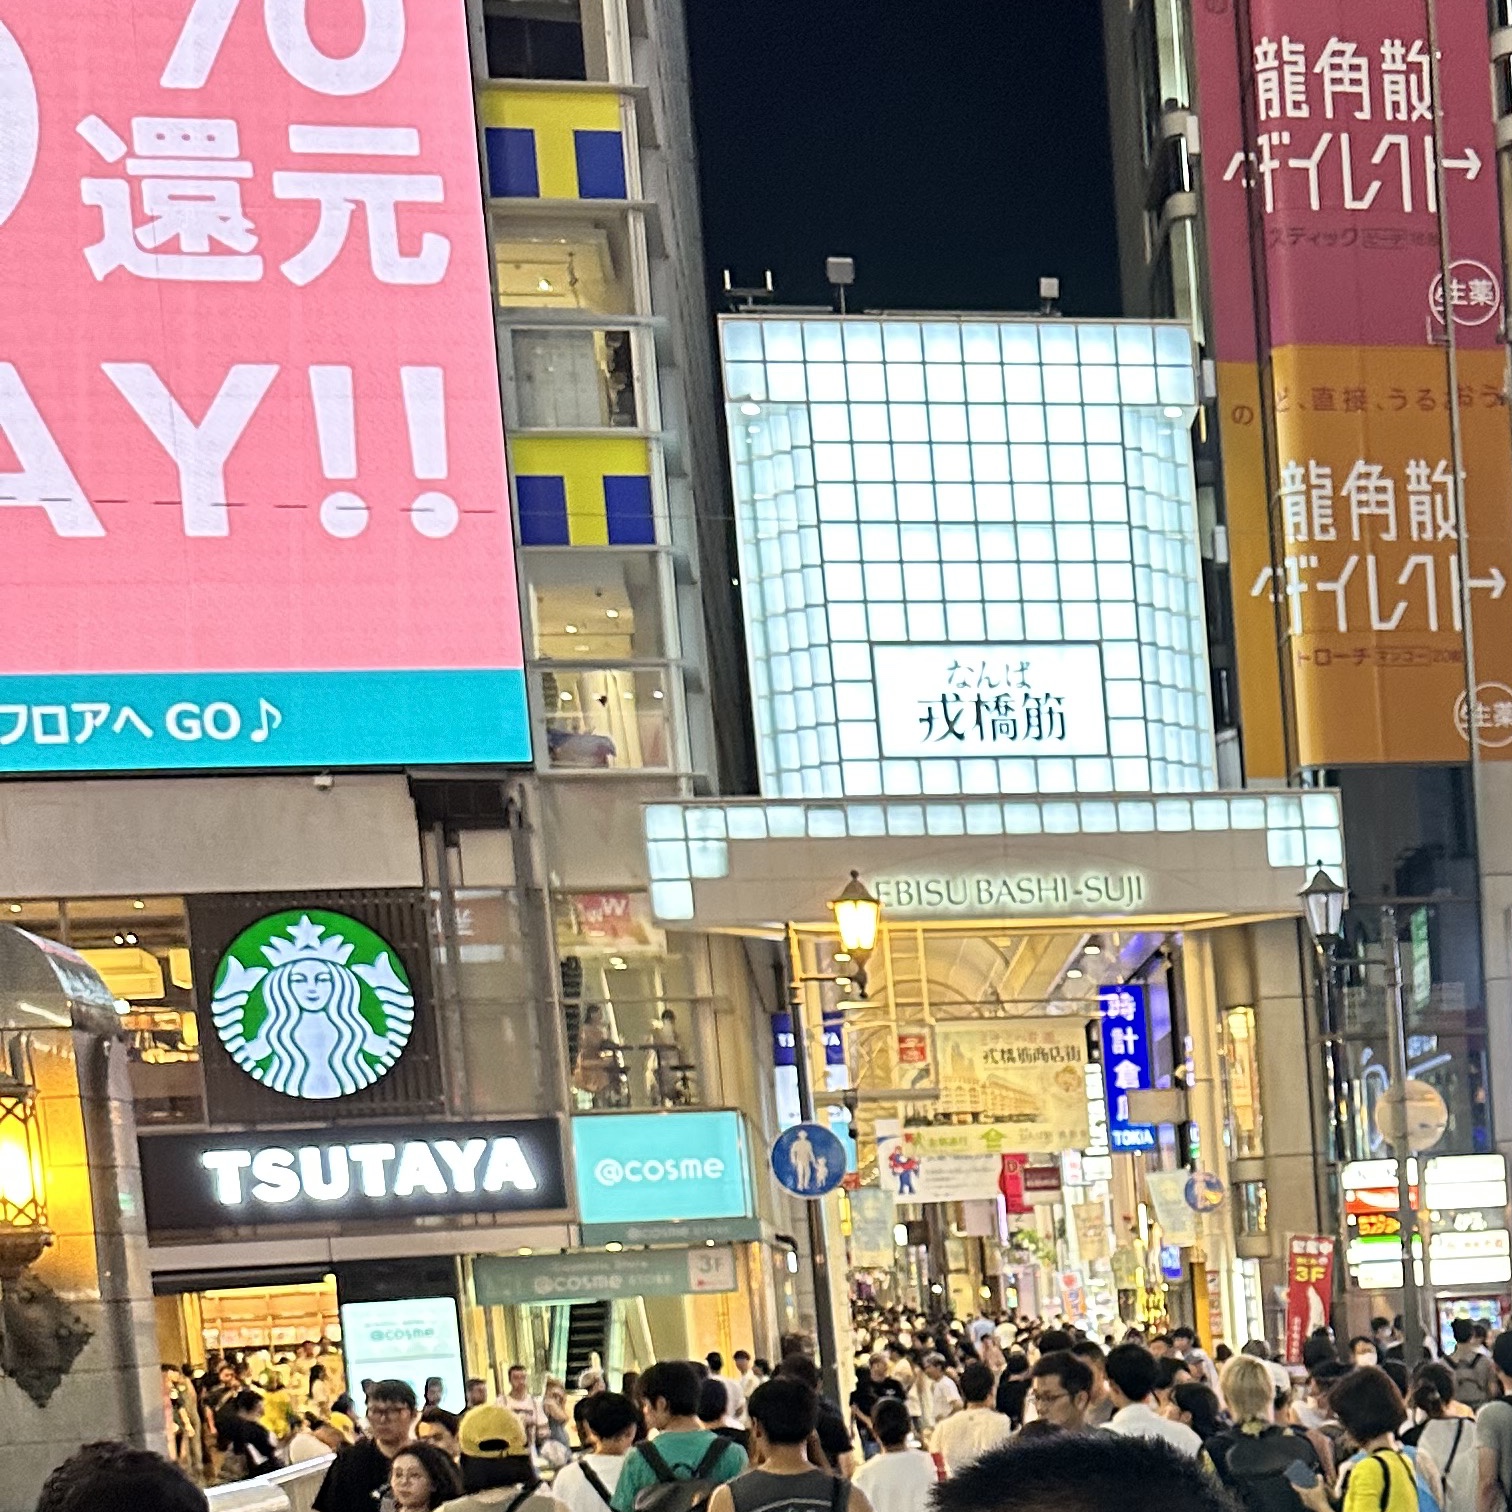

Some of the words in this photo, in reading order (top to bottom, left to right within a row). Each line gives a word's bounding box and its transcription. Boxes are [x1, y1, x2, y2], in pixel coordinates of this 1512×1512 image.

[1254, 36, 1442, 122] 龍角散
[76, 113, 451, 286] 還元
[1281, 457, 1467, 542] 龍角散
[946, 660, 1031, 689] なんば
[165, 701, 241, 741] GO
[918, 692, 1067, 744] 戎橋筋
[203, 1136, 537, 1205] TSUTAYA
[594, 1154, 726, 1187] @cosme
[533, 1274, 623, 1295] @cosme
[1295, 1265, 1328, 1283] 3F
[370, 1327, 435, 1342] @cosme
